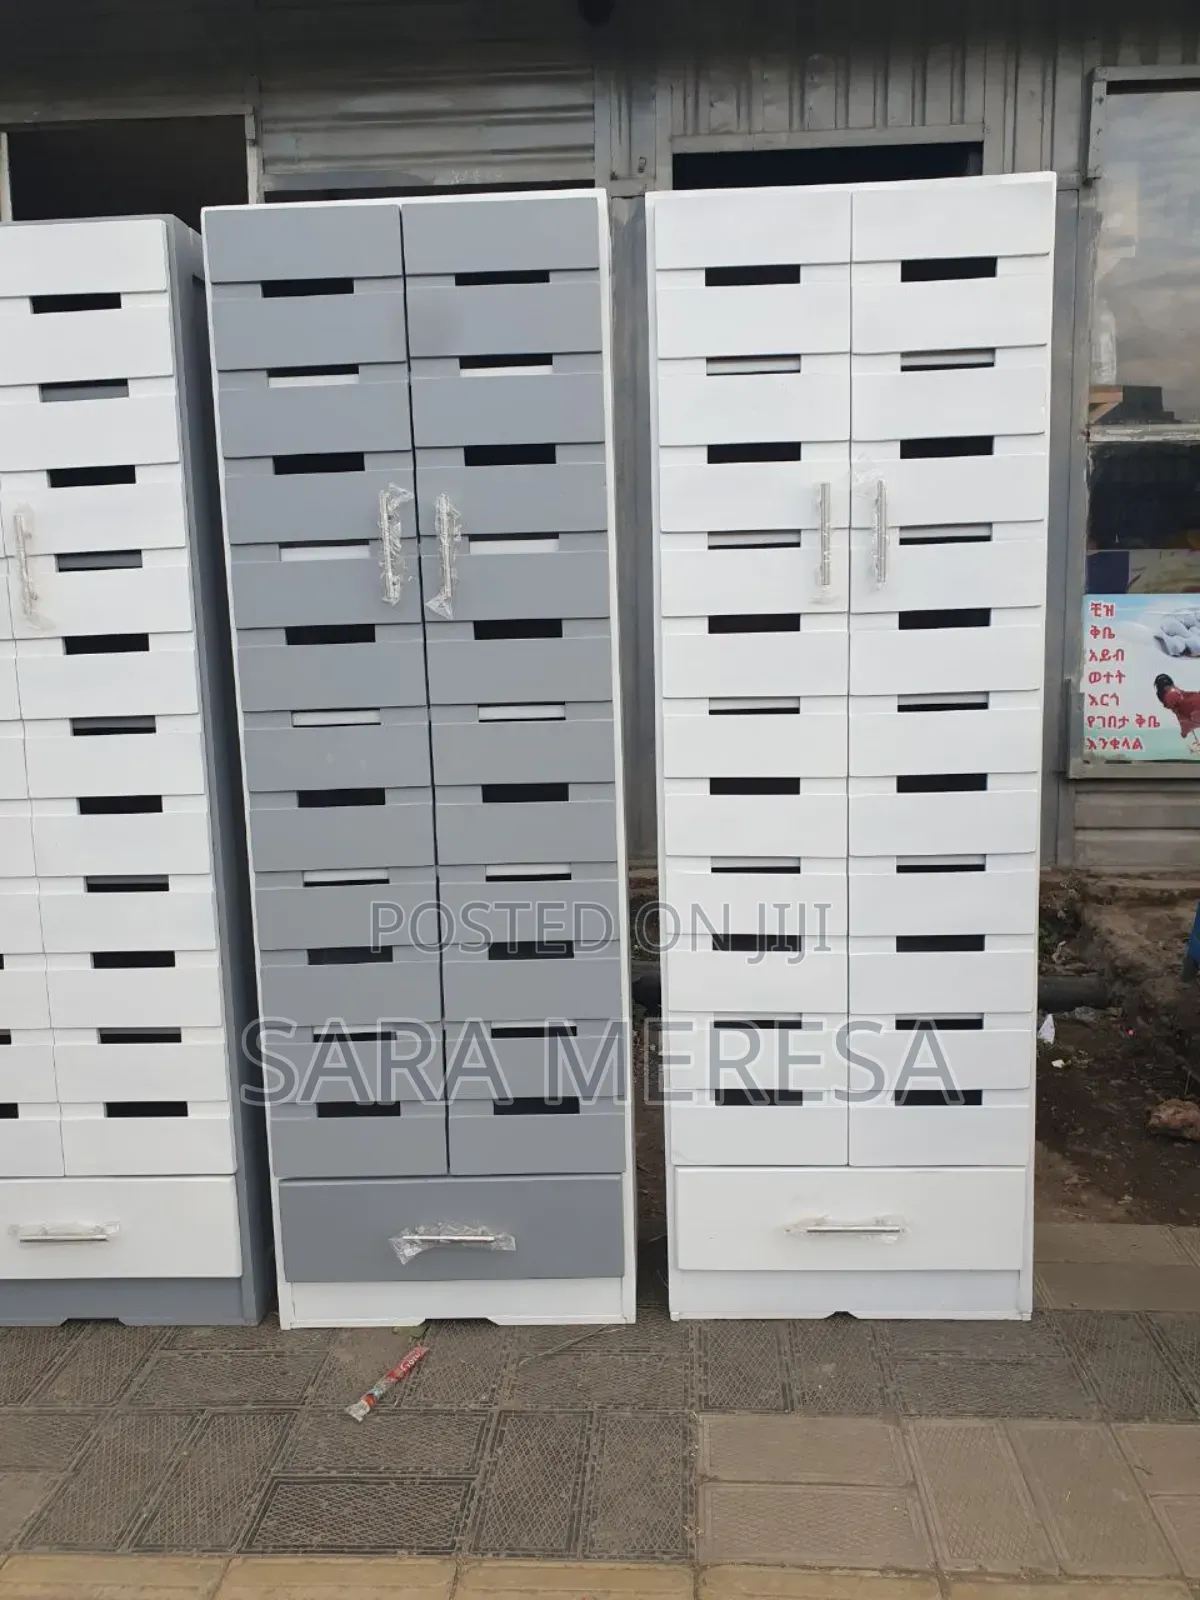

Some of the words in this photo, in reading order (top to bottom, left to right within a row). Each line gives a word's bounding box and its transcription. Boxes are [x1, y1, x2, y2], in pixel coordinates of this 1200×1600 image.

[1089, 624, 1116, 639] ቅቤ
[1088, 648, 1125, 662] አይብ
[1088, 669, 1126, 684] ወተት
[1087, 714, 1130, 729] የገበታ
[1134, 713, 1161, 729] ቅቤ
